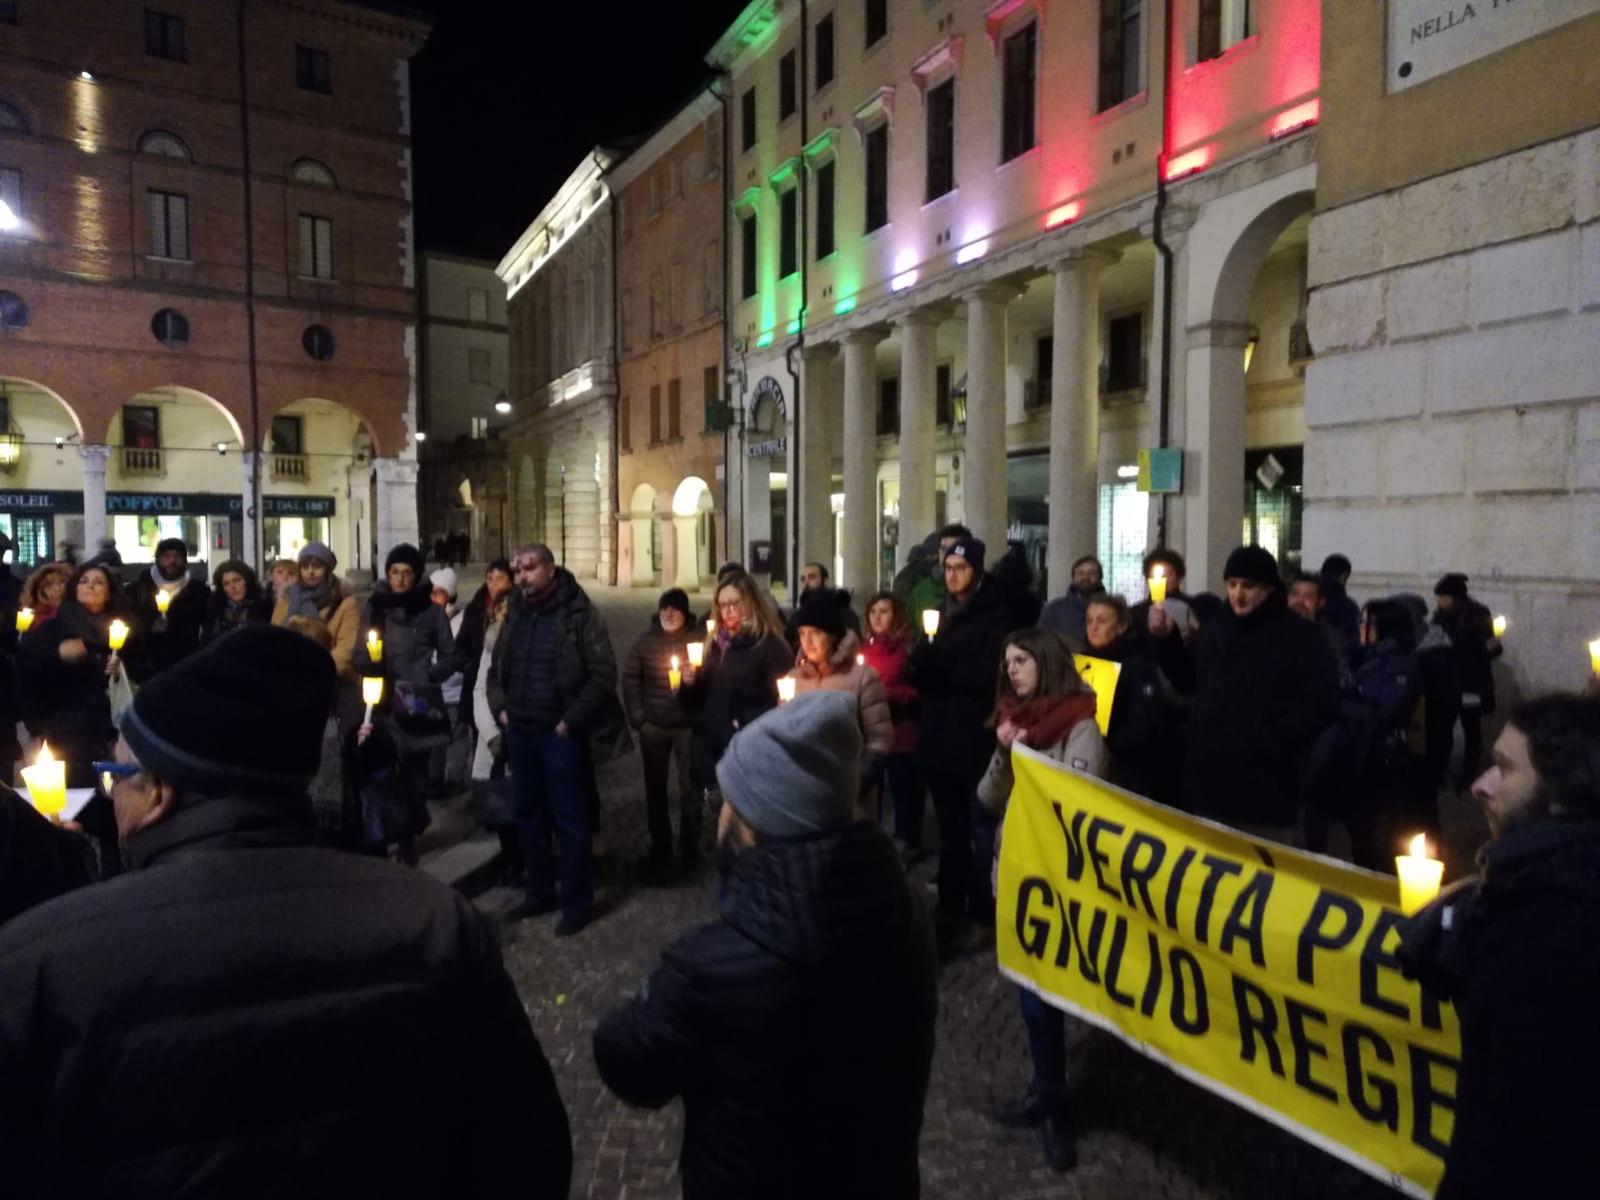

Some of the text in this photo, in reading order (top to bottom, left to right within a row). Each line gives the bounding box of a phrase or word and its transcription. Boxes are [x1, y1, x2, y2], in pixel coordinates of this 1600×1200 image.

[1410, 4, 1477, 44] NELLA
[749, 437, 785, 457] CENTRALE
[1052, 800, 1276, 969] VERITÀ
[1015, 875, 1210, 1038] GIULIO
